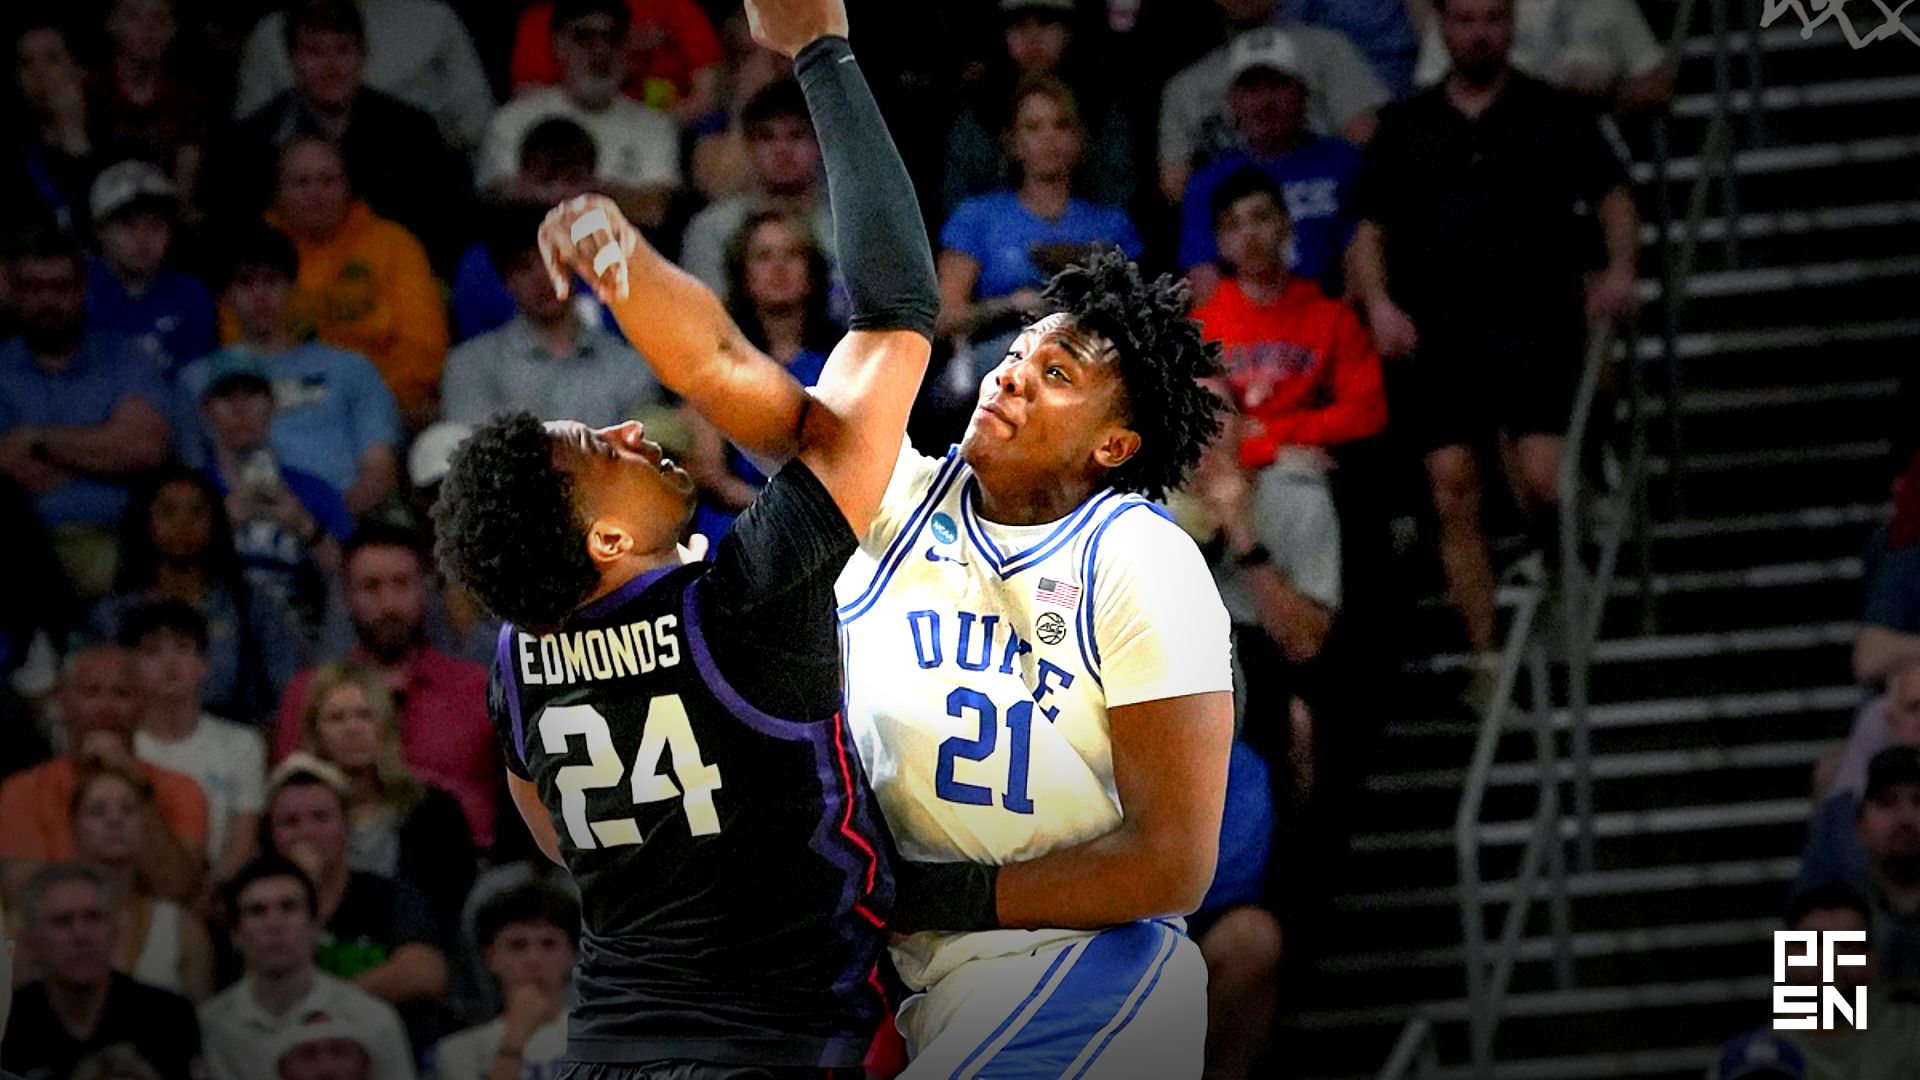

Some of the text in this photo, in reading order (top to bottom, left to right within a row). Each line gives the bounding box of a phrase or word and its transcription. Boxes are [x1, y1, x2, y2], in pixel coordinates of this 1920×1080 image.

[518, 614, 680, 685] EDMONDS
[538, 694, 722, 850] 24
[935, 687, 1035, 814] 21
